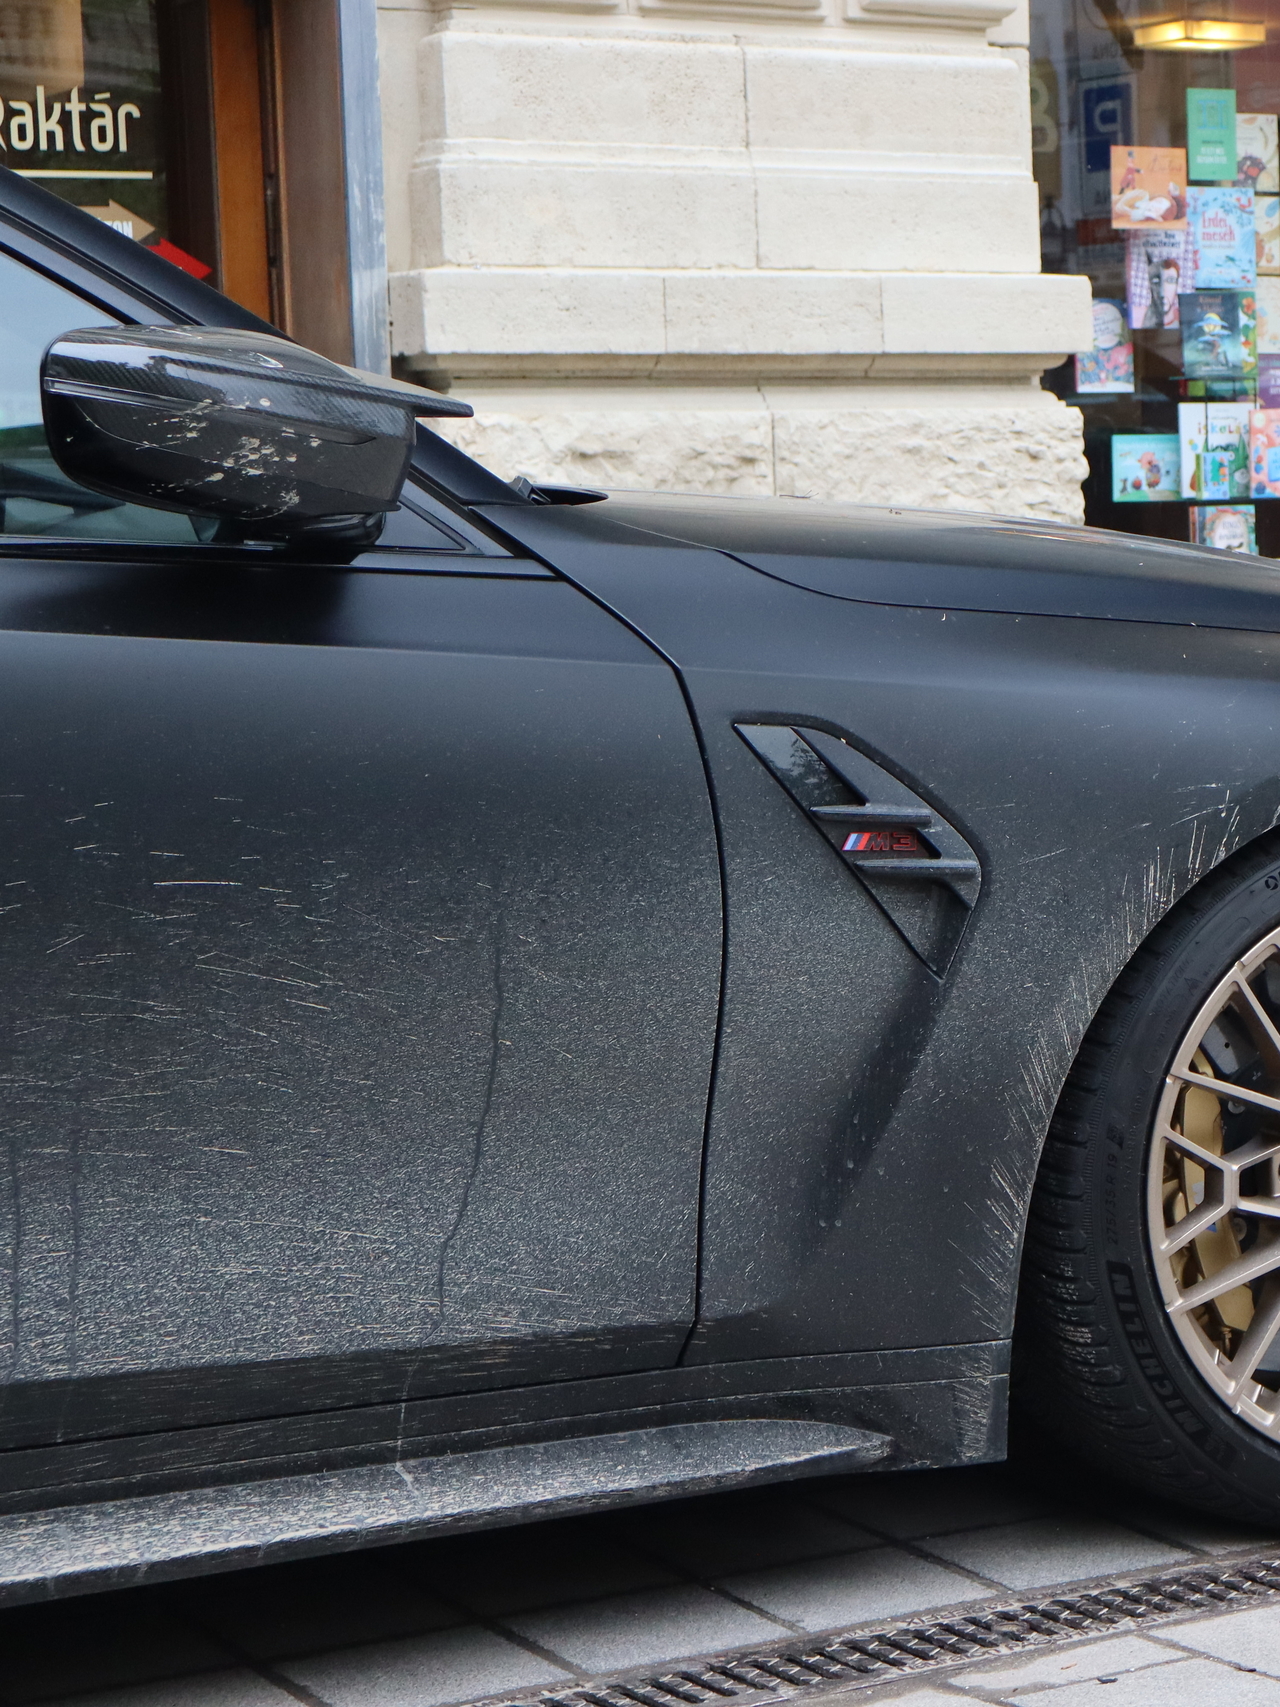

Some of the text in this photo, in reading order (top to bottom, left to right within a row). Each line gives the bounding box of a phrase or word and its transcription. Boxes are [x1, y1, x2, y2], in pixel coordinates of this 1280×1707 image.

[863, 831, 918, 851] M3
[1105, 1153, 1118, 1245] 275/35 R 19
[1112, 1273, 1204, 1433] MICHELIN
